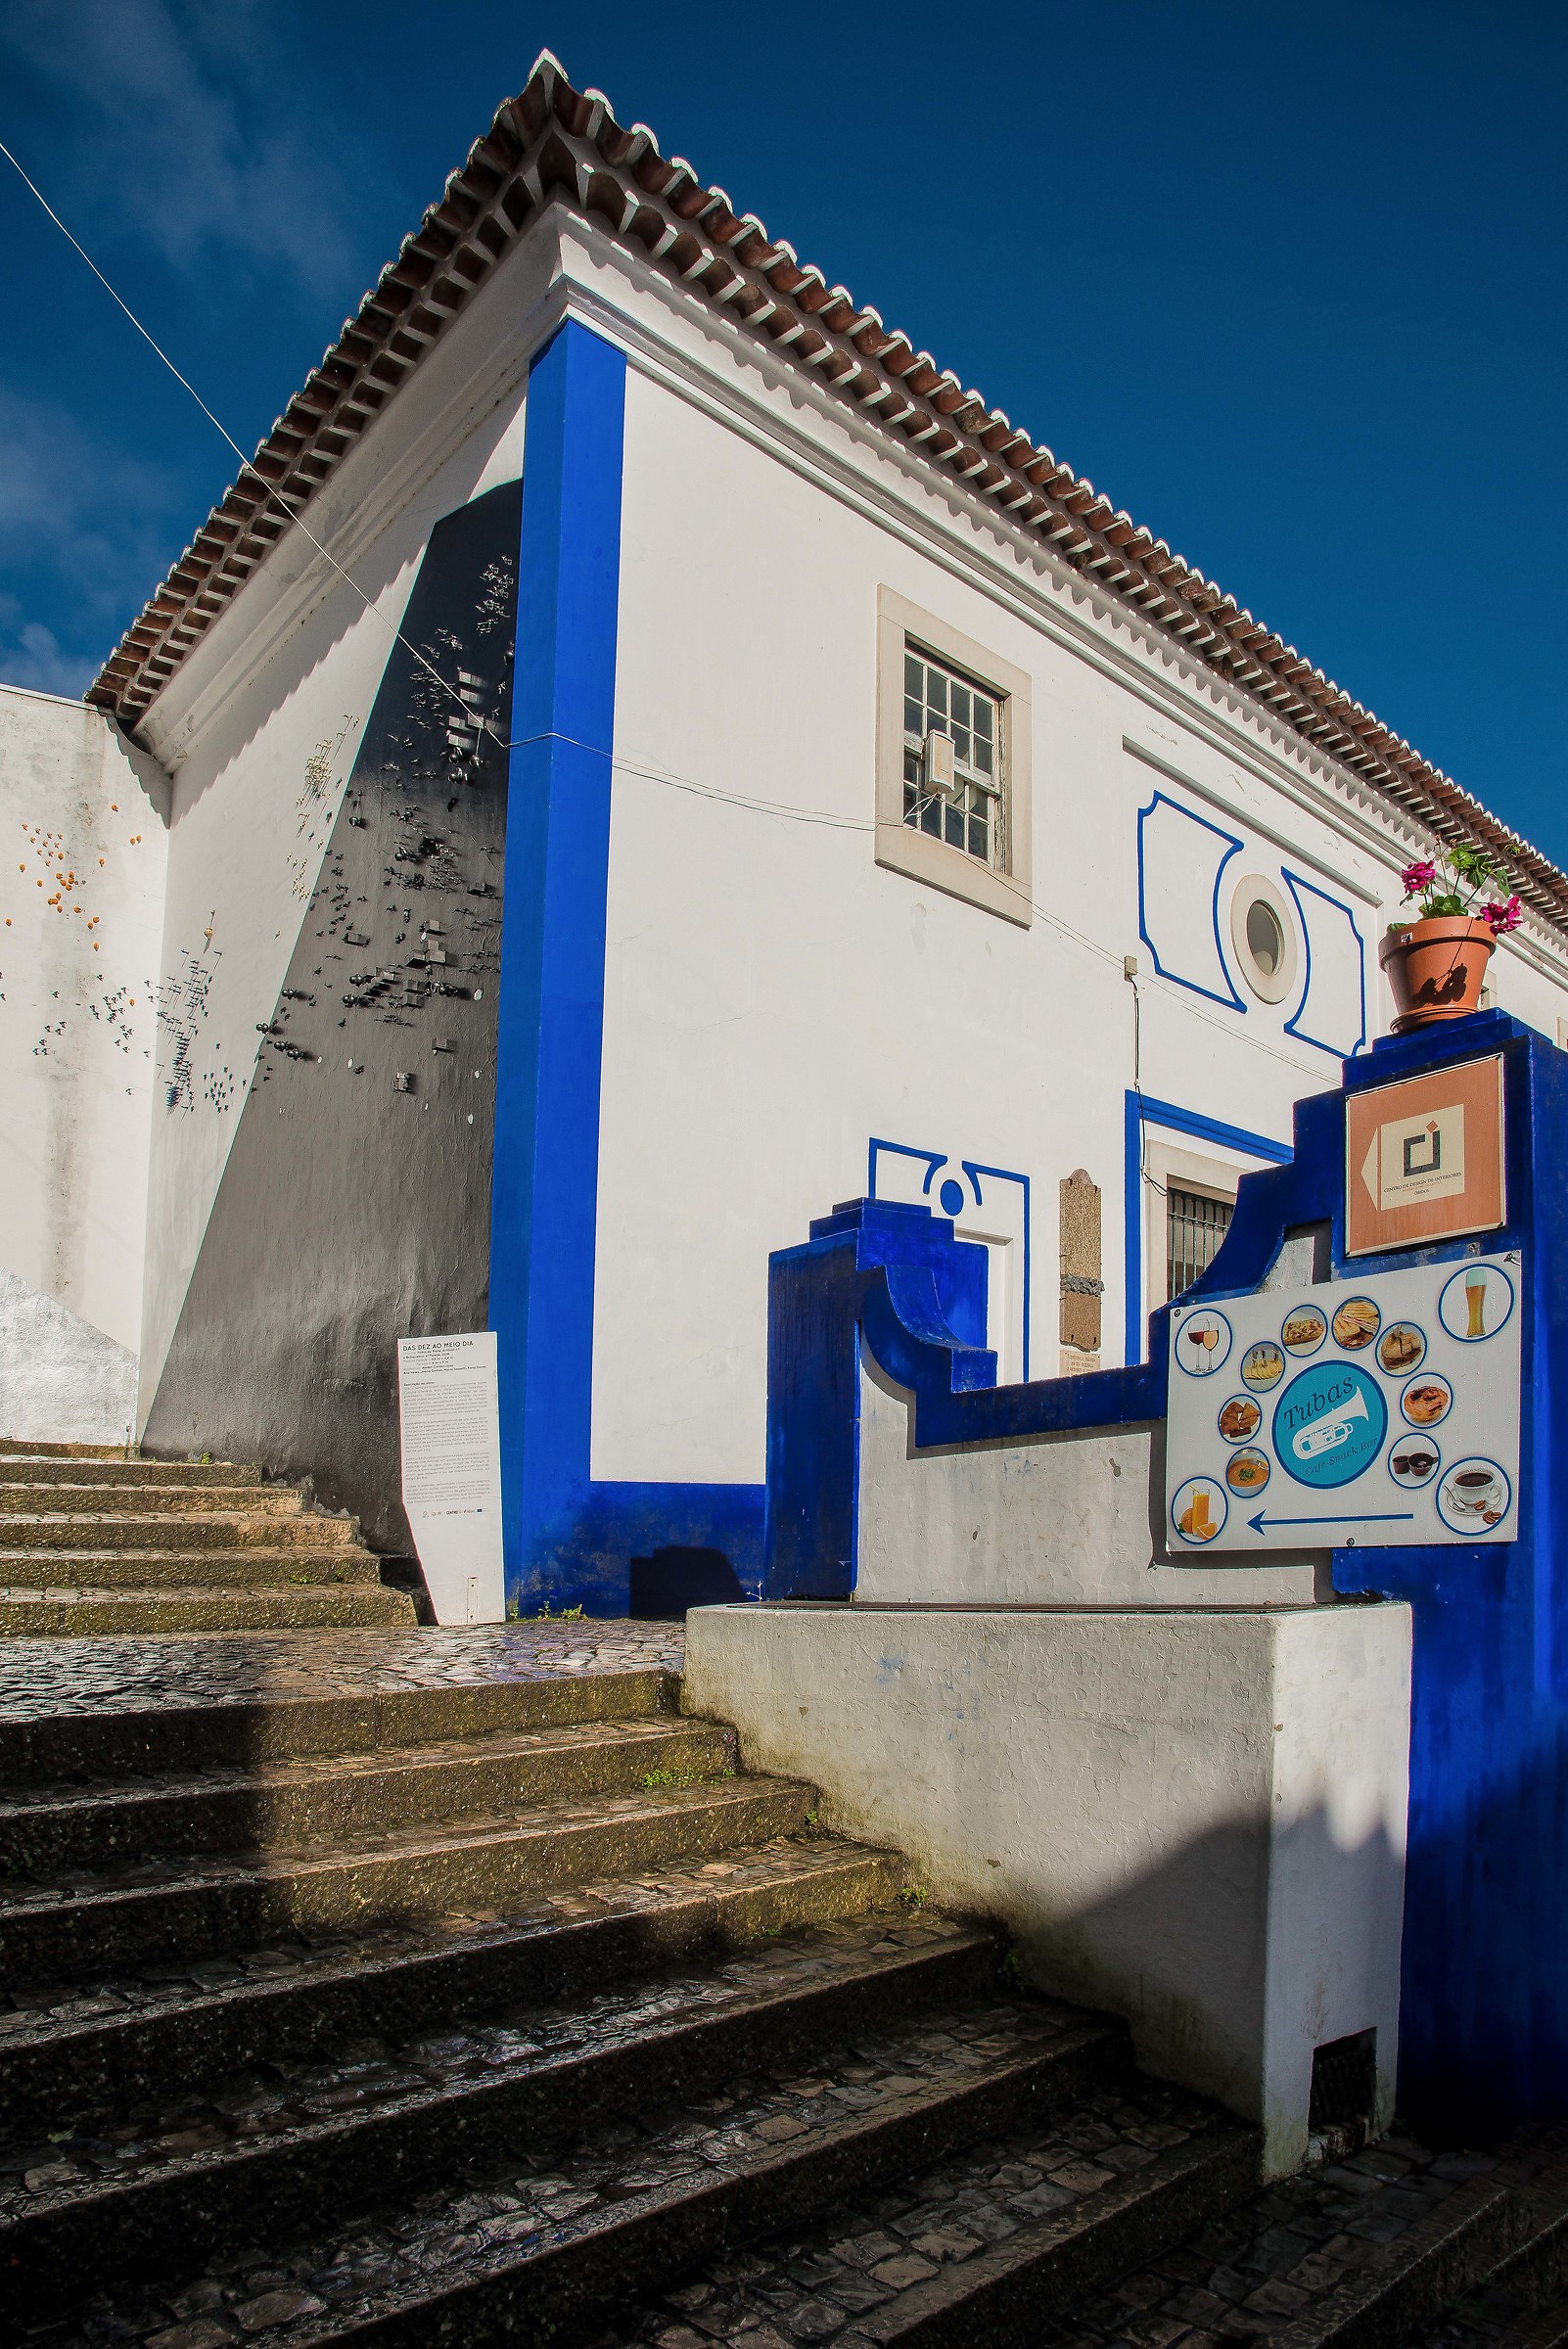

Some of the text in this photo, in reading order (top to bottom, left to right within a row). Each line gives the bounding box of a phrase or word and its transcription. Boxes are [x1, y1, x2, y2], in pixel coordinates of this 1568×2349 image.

[1384, 1184, 1403, 1193] CENTRO
[1434, 1172, 1462, 1180] INTERIORES
[1283, 1376, 1354, 1430] Tubas
[1305, 1437, 1378, 1476] Café-Snack Bar
